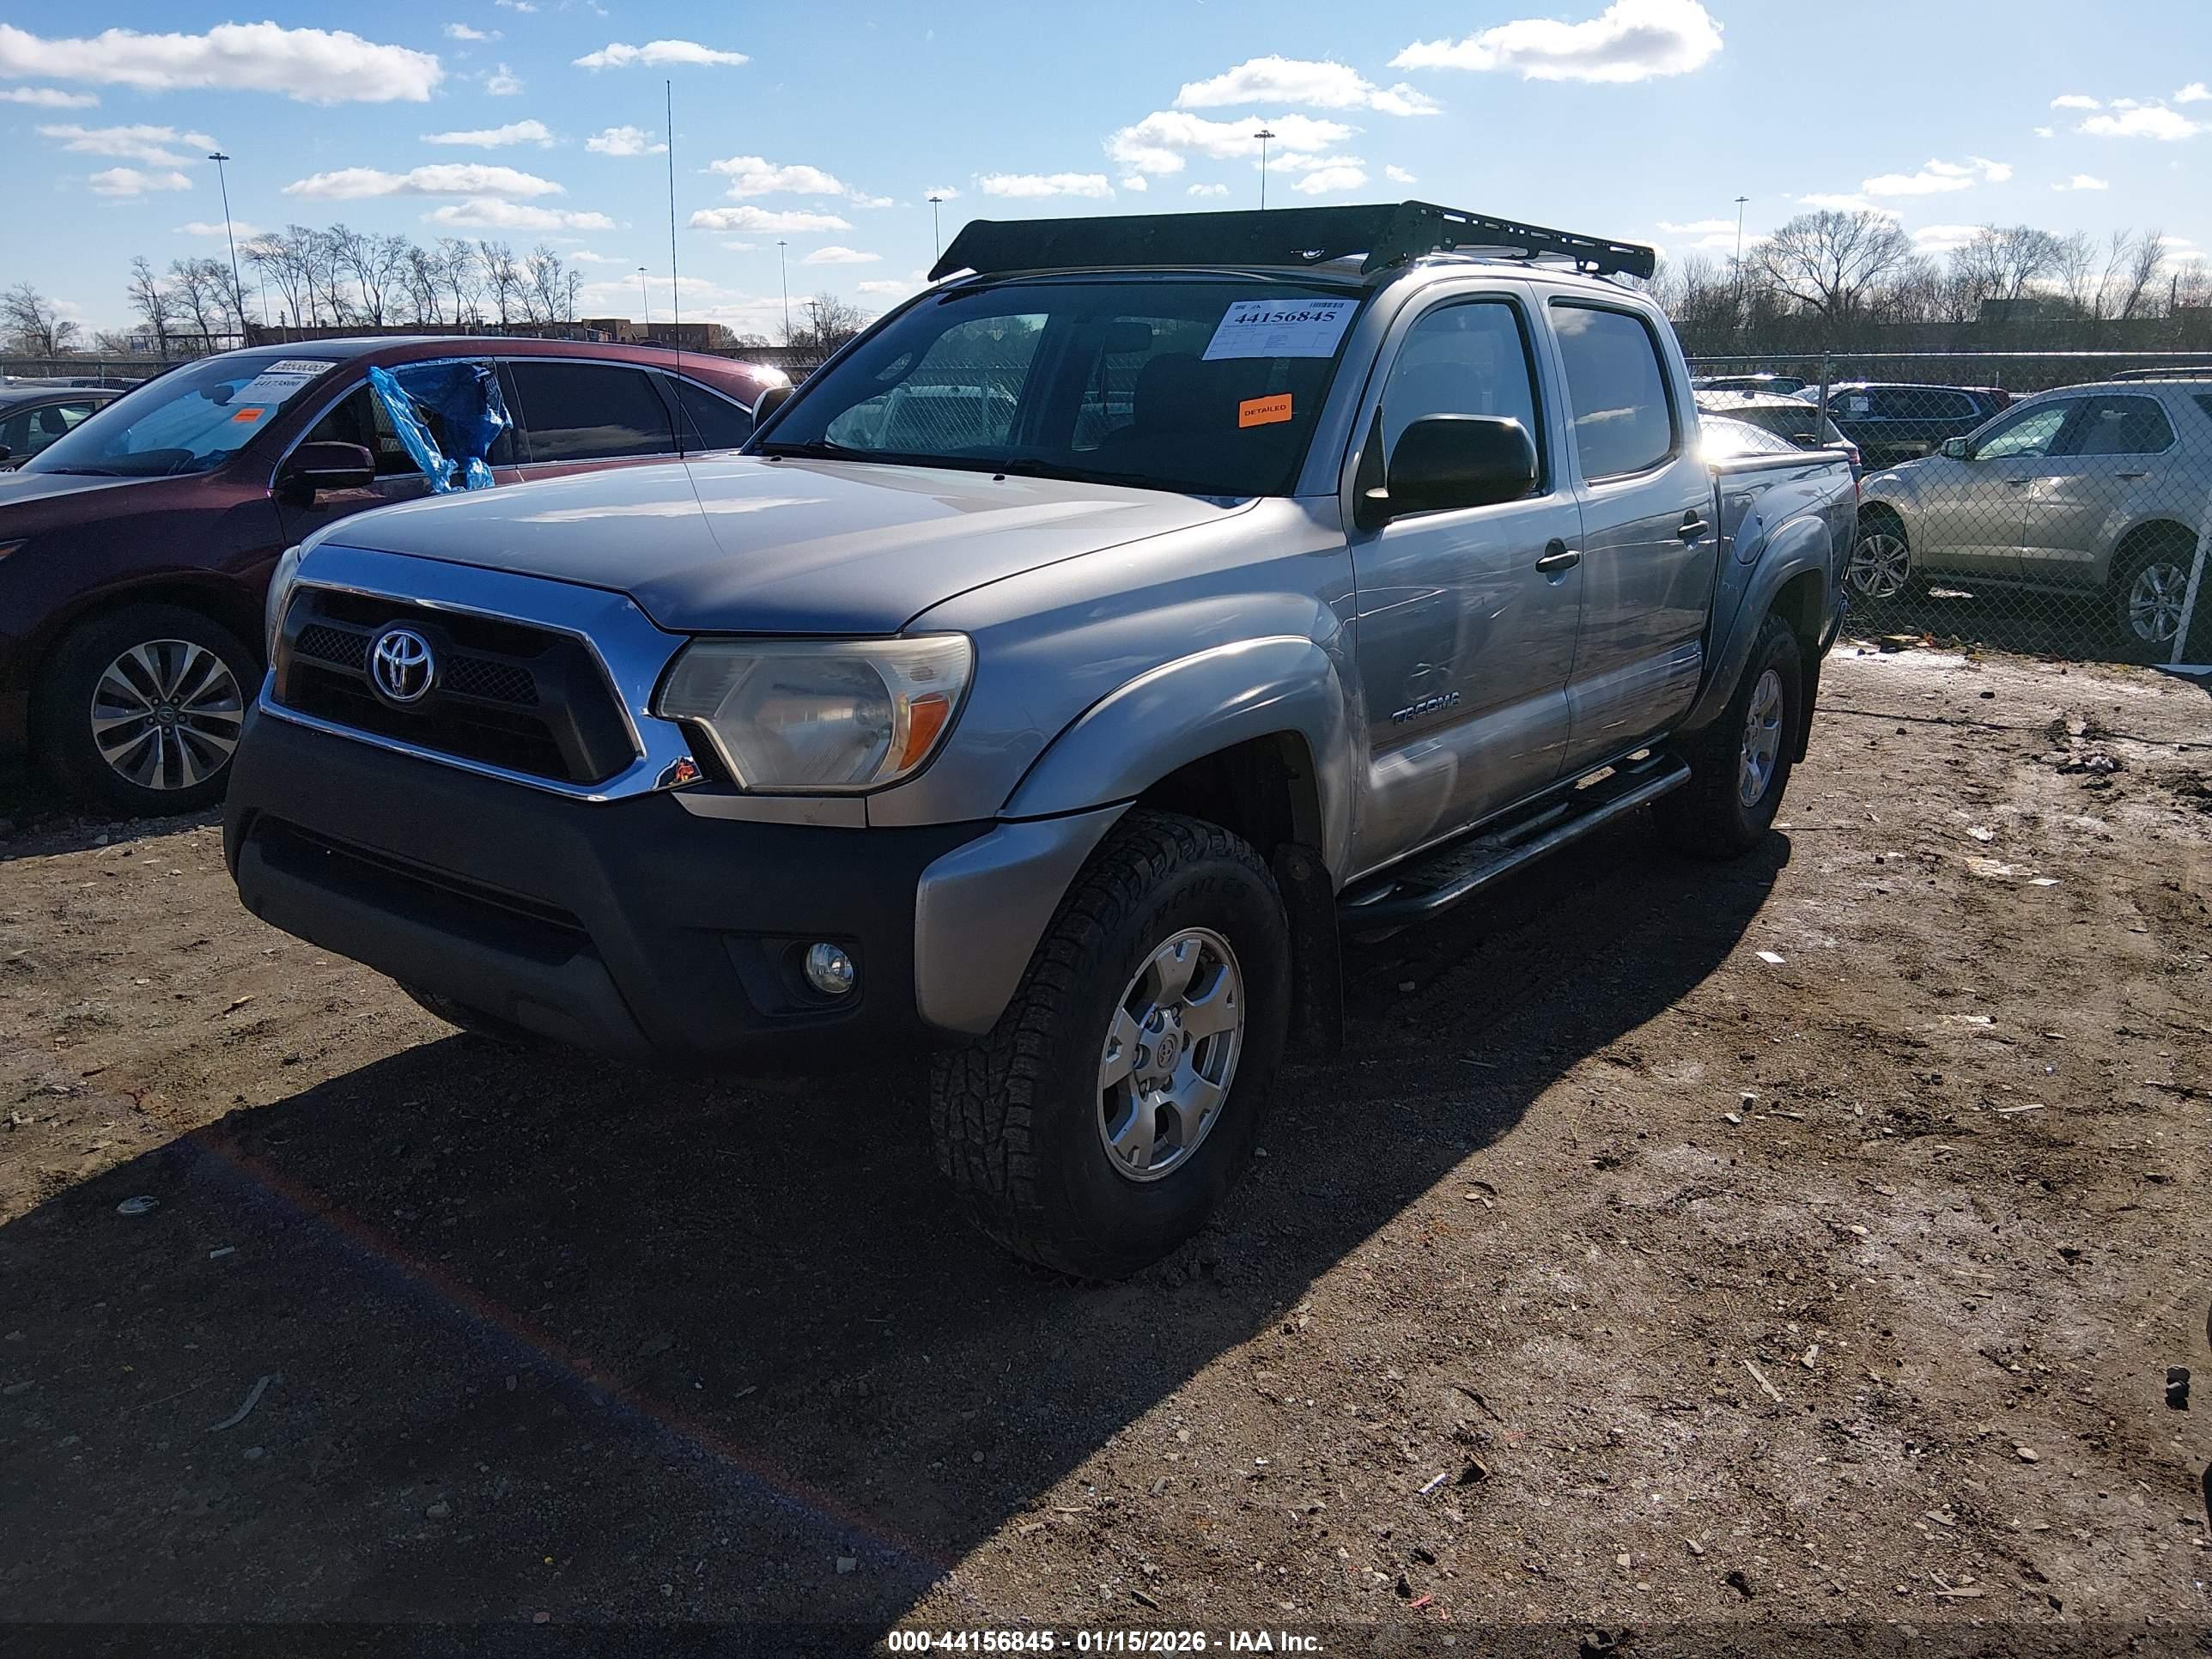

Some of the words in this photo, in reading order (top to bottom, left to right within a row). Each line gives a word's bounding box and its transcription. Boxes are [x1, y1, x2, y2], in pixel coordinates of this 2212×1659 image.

[1234, 311, 1338, 324] 44156845
[1244, 404, 1287, 416] DETAILED
[1390, 690, 1461, 726] TACOMA
